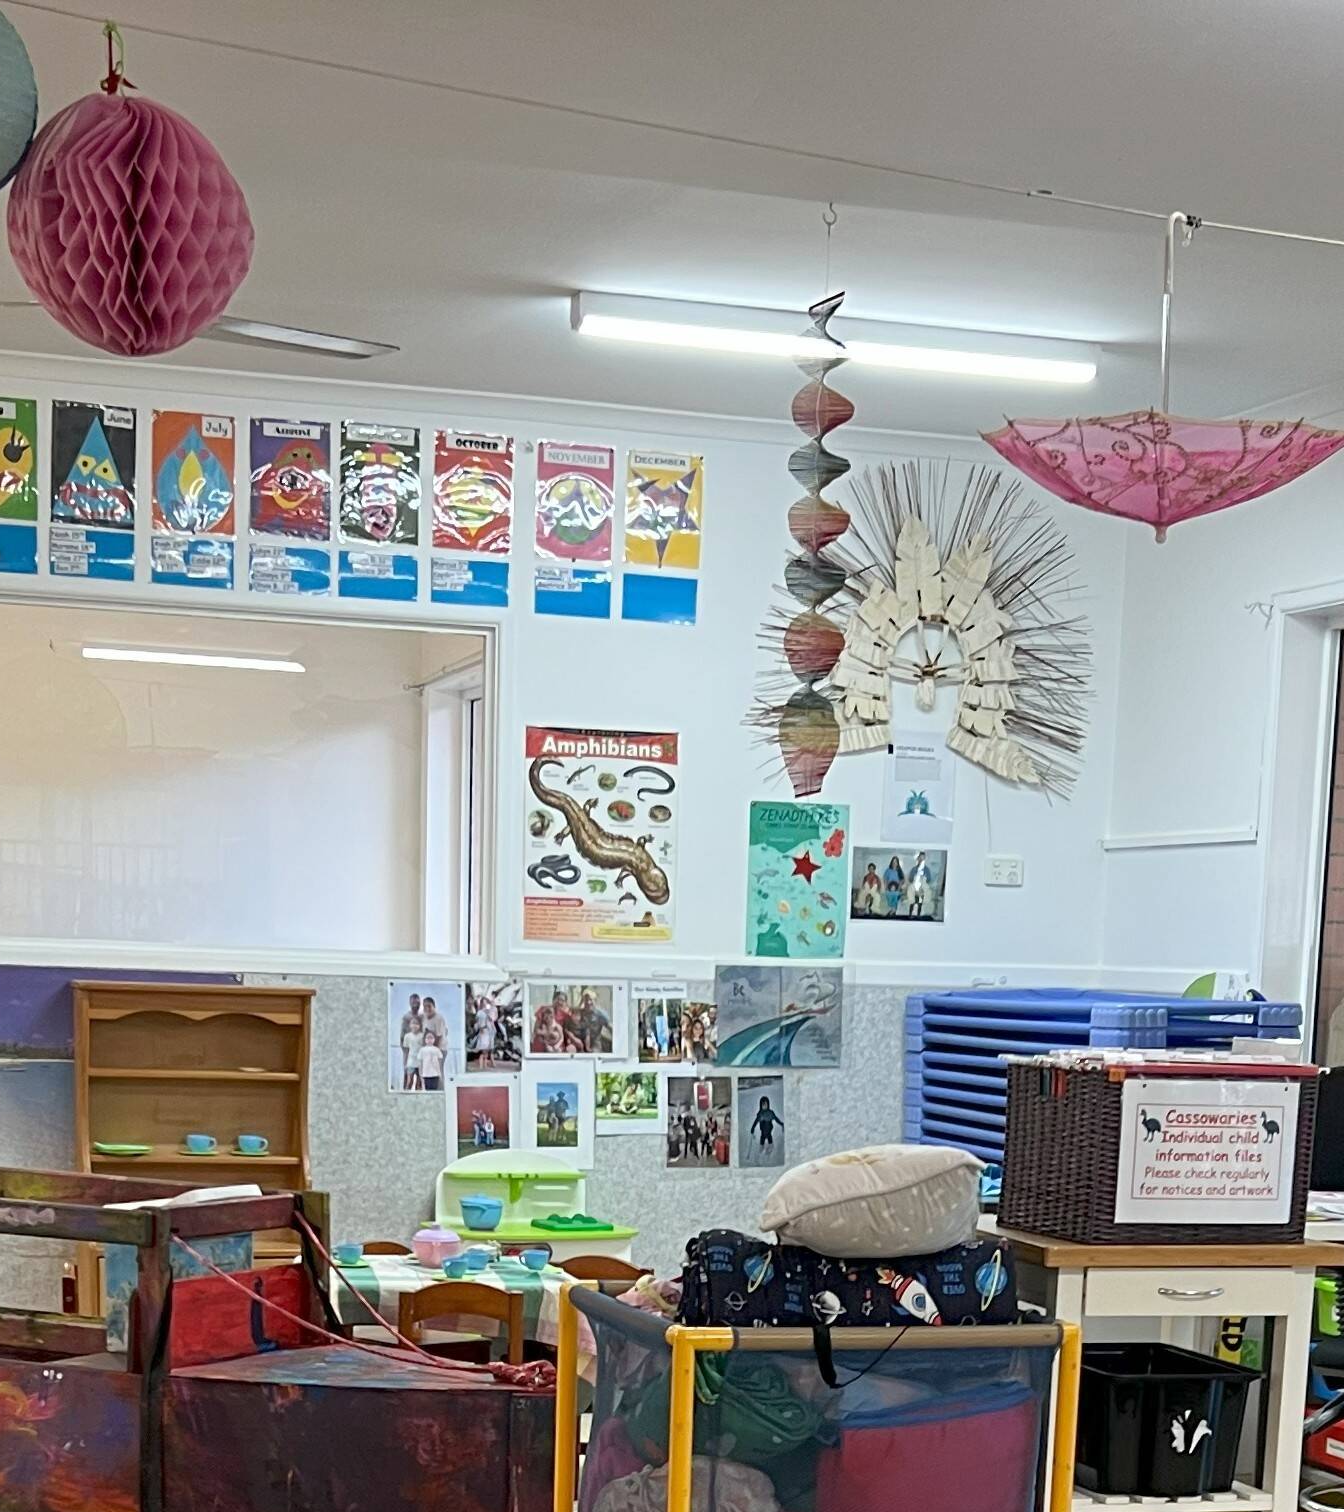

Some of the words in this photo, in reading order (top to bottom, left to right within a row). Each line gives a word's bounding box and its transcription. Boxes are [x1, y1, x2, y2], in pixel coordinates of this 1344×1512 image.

[107, 412, 132, 425] June
[205, 421, 228, 436] July
[456, 438, 498, 450] OCTOBER
[547, 451, 606, 465] NOVEMBER
[634, 455, 686, 466] DECEMBER
[542, 737, 662, 758] Amphibians
[1165, 1109, 1257, 1125] Cassowaries
[1161, 1130, 1223, 1144] Individual
[1229, 1132, 1259, 1144] child
[1155, 1149, 1228, 1163] information
[1235, 1149, 1262, 1163] files
[1144, 1166, 1180, 1179] Please
[1185, 1167, 1216, 1179] check
[1221, 1168, 1269, 1181] regularly
[1139, 1182, 1158, 1196] for
[1162, 1184, 1202, 1195] notices
[1206, 1184, 1225, 1195] and
[1229, 1184, 1273, 1196] artwork
